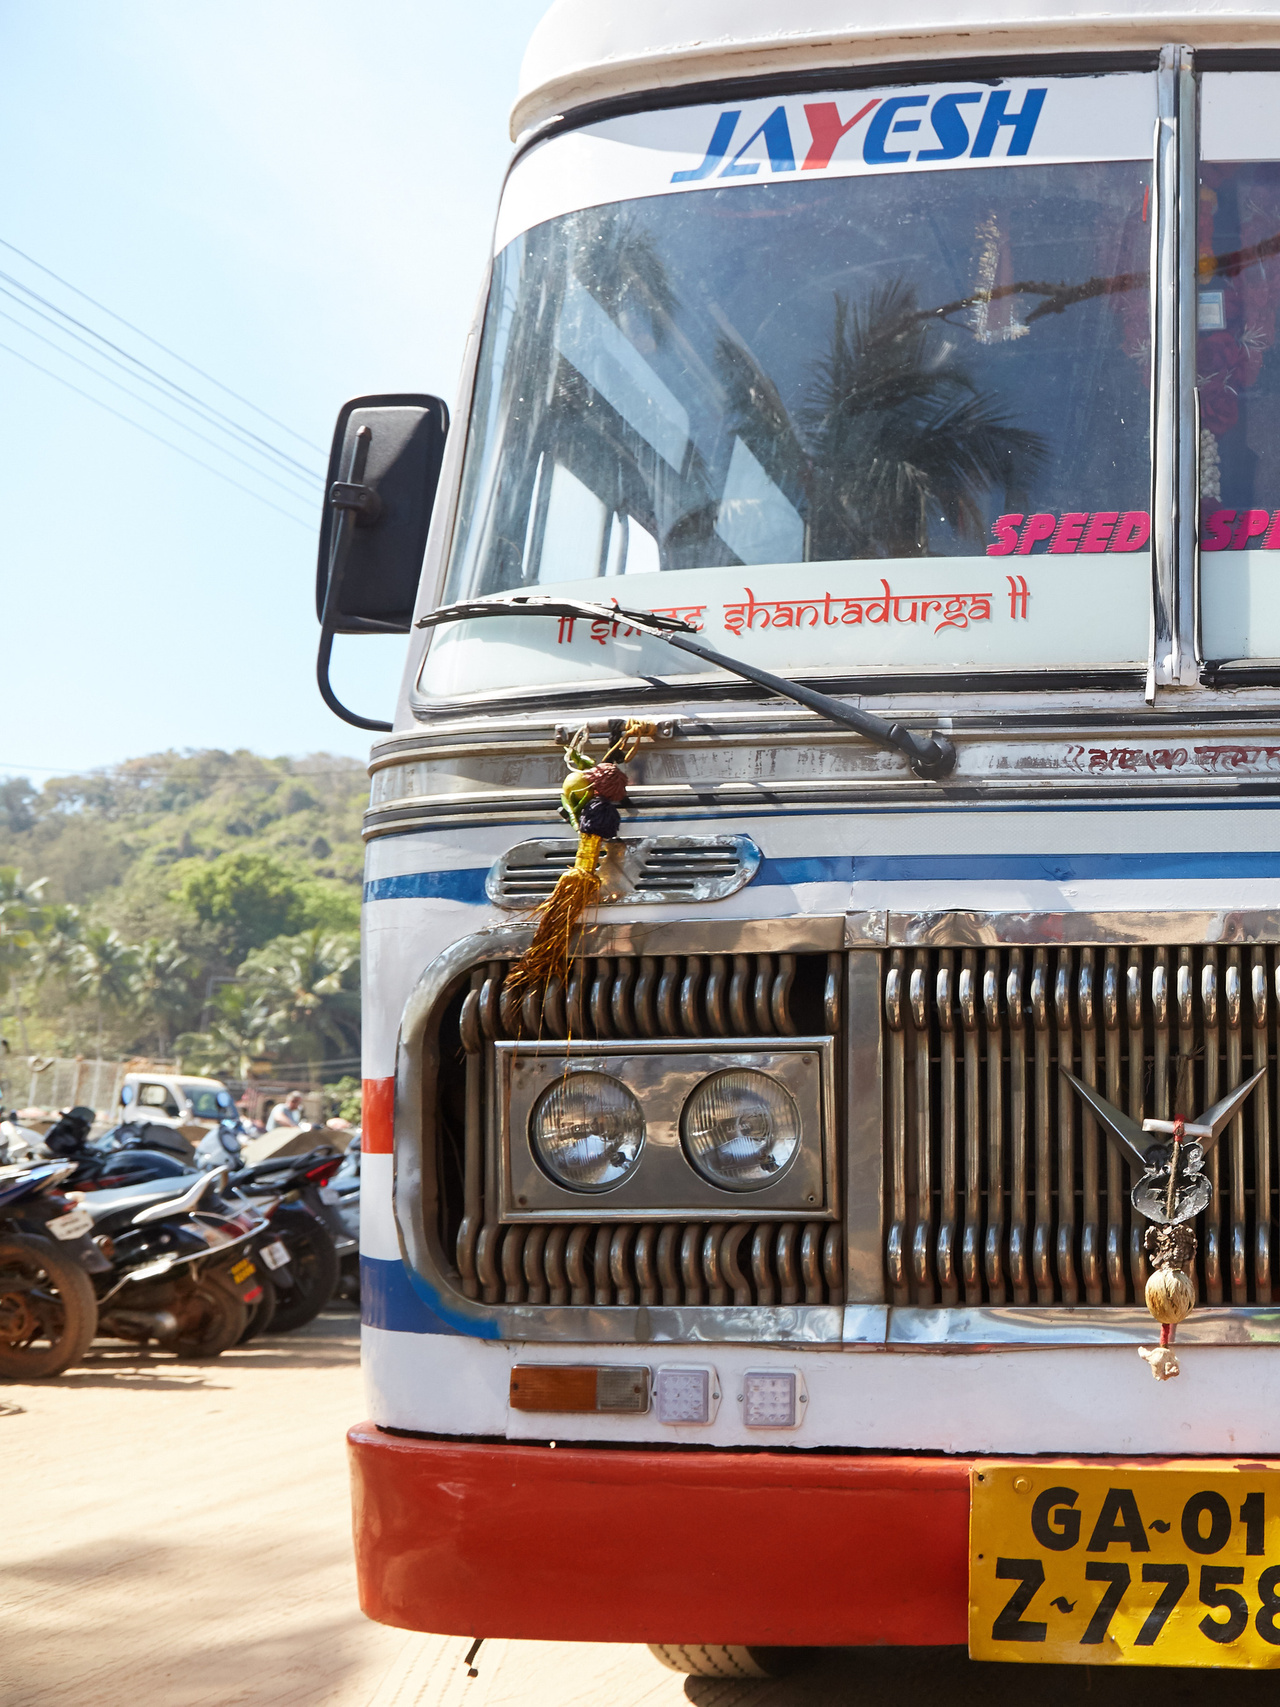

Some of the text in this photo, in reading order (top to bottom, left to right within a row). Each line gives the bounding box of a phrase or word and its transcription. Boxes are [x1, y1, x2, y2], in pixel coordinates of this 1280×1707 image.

[670, 88, 1048, 184] JAYESH
[986, 511, 1151, 557] SPEED
[723, 578, 993, 636] shantadurga
